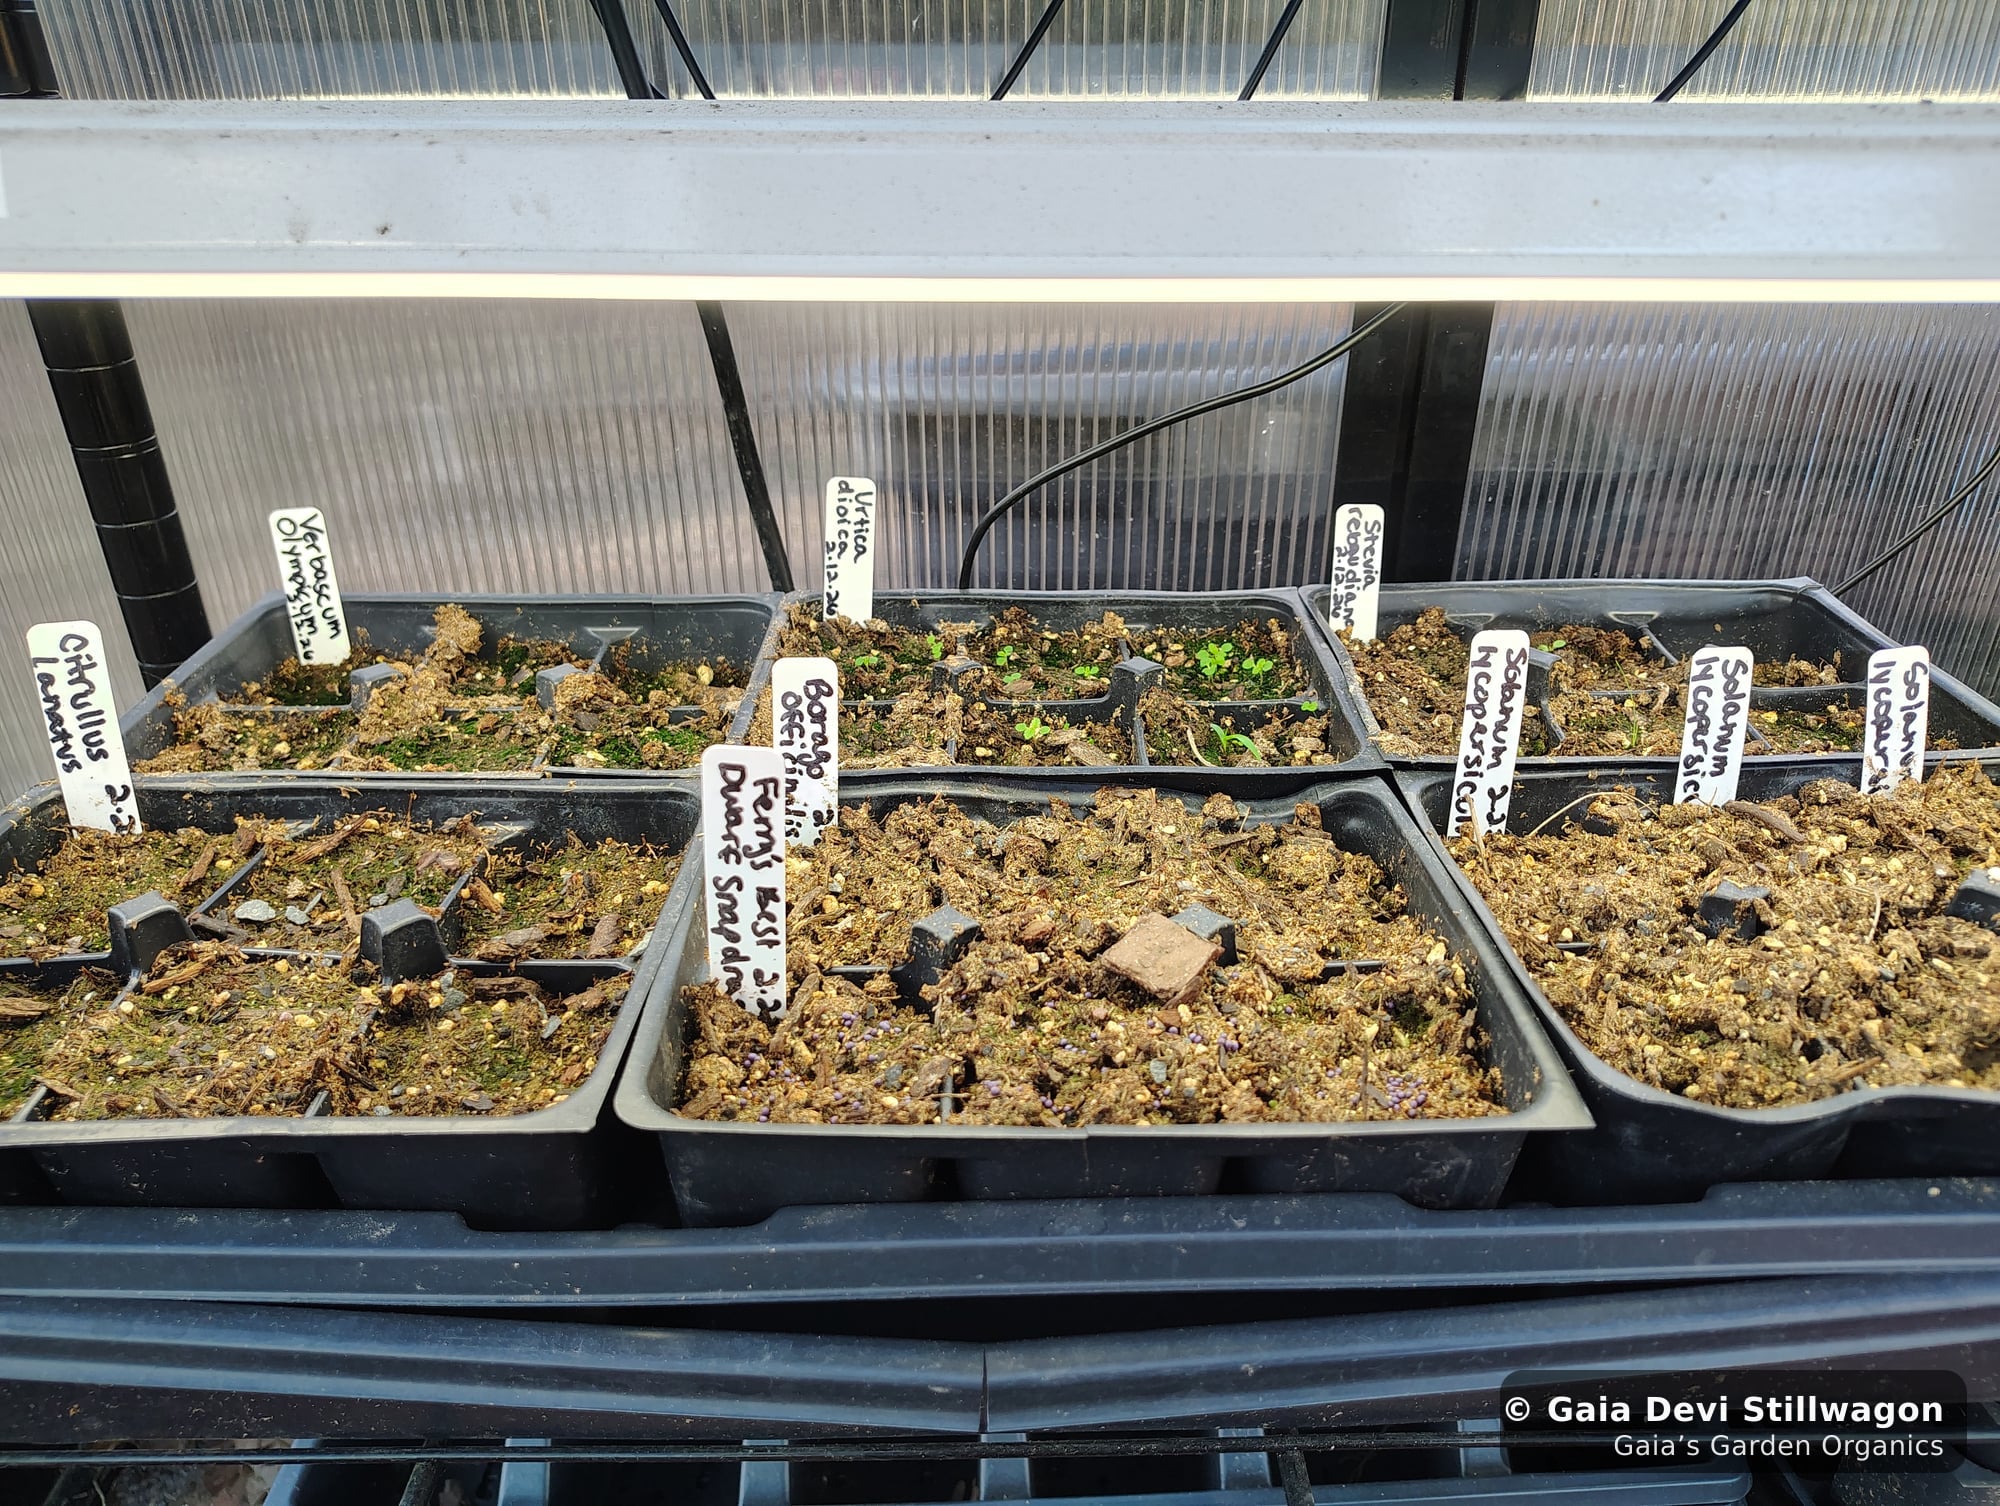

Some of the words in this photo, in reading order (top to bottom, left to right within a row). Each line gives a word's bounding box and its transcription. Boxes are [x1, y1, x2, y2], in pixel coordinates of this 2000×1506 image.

[854, 491, 874, 564] Urtica
[1362, 520, 1381, 591] Stevia
[825, 541, 840, 616] 2.12.26
[796, 679, 834, 780] Borago
[1486, 648, 1528, 770] Solanum
[1710, 659, 1749, 777] Solanum
[752, 887, 782, 949] Best
